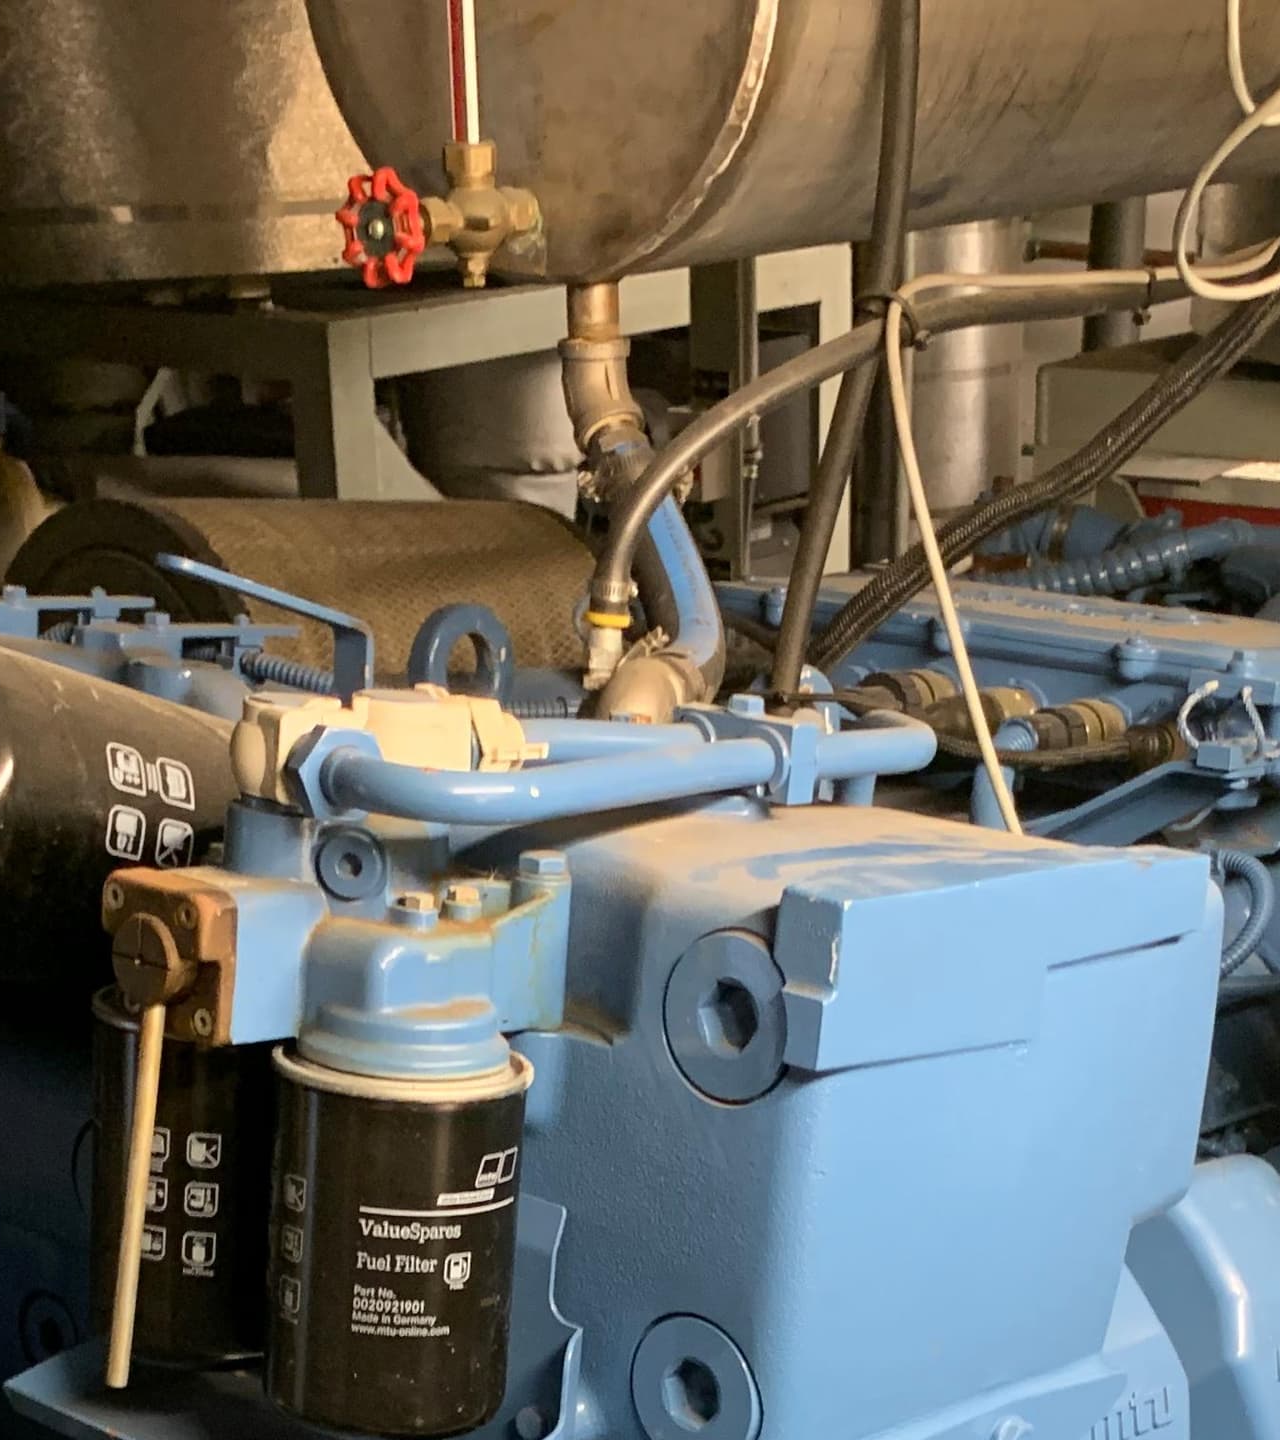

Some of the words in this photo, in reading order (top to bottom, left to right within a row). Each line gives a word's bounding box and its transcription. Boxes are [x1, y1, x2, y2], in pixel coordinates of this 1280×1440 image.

[358, 1218, 462, 1244] ValueSpares
[356, 1251, 391, 1272] Fuel
[394, 1254, 438, 1273] Filter
[353, 1284, 376, 1298] Part
[352, 1297, 425, 1314] 0020921901
[352, 1310, 379, 1324] Made
[393, 1312, 437, 1327] Germany
[351, 1323, 450, 1337] www.mtu-online.com
